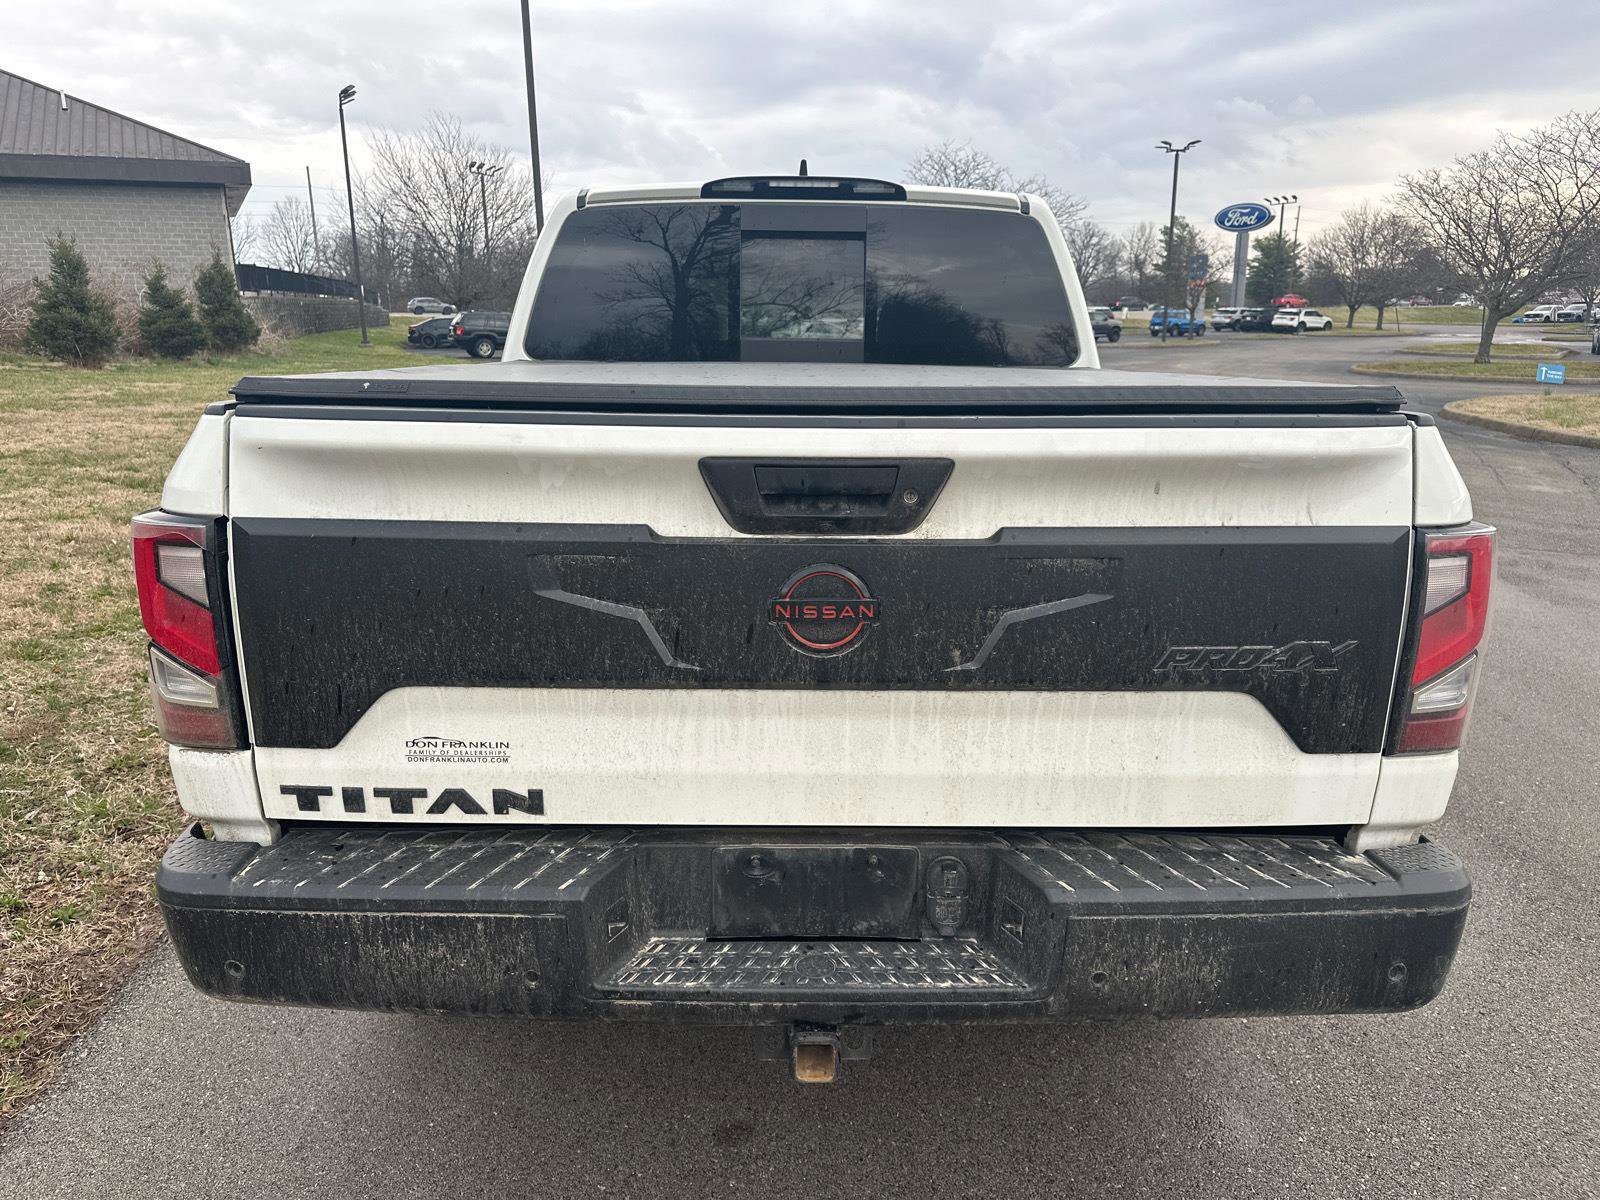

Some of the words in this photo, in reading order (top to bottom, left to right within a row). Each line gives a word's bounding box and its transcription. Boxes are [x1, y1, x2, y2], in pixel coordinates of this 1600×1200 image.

[1224, 208, 1259, 227] Ford
[774, 604, 875, 619] NISSAN
[405, 740, 438, 749] DON
[441, 741, 510, 749] FRANKLIN
[407, 756, 509, 764] DONFRANKLINAUTO.COM
[279, 784, 545, 816] TITAN
